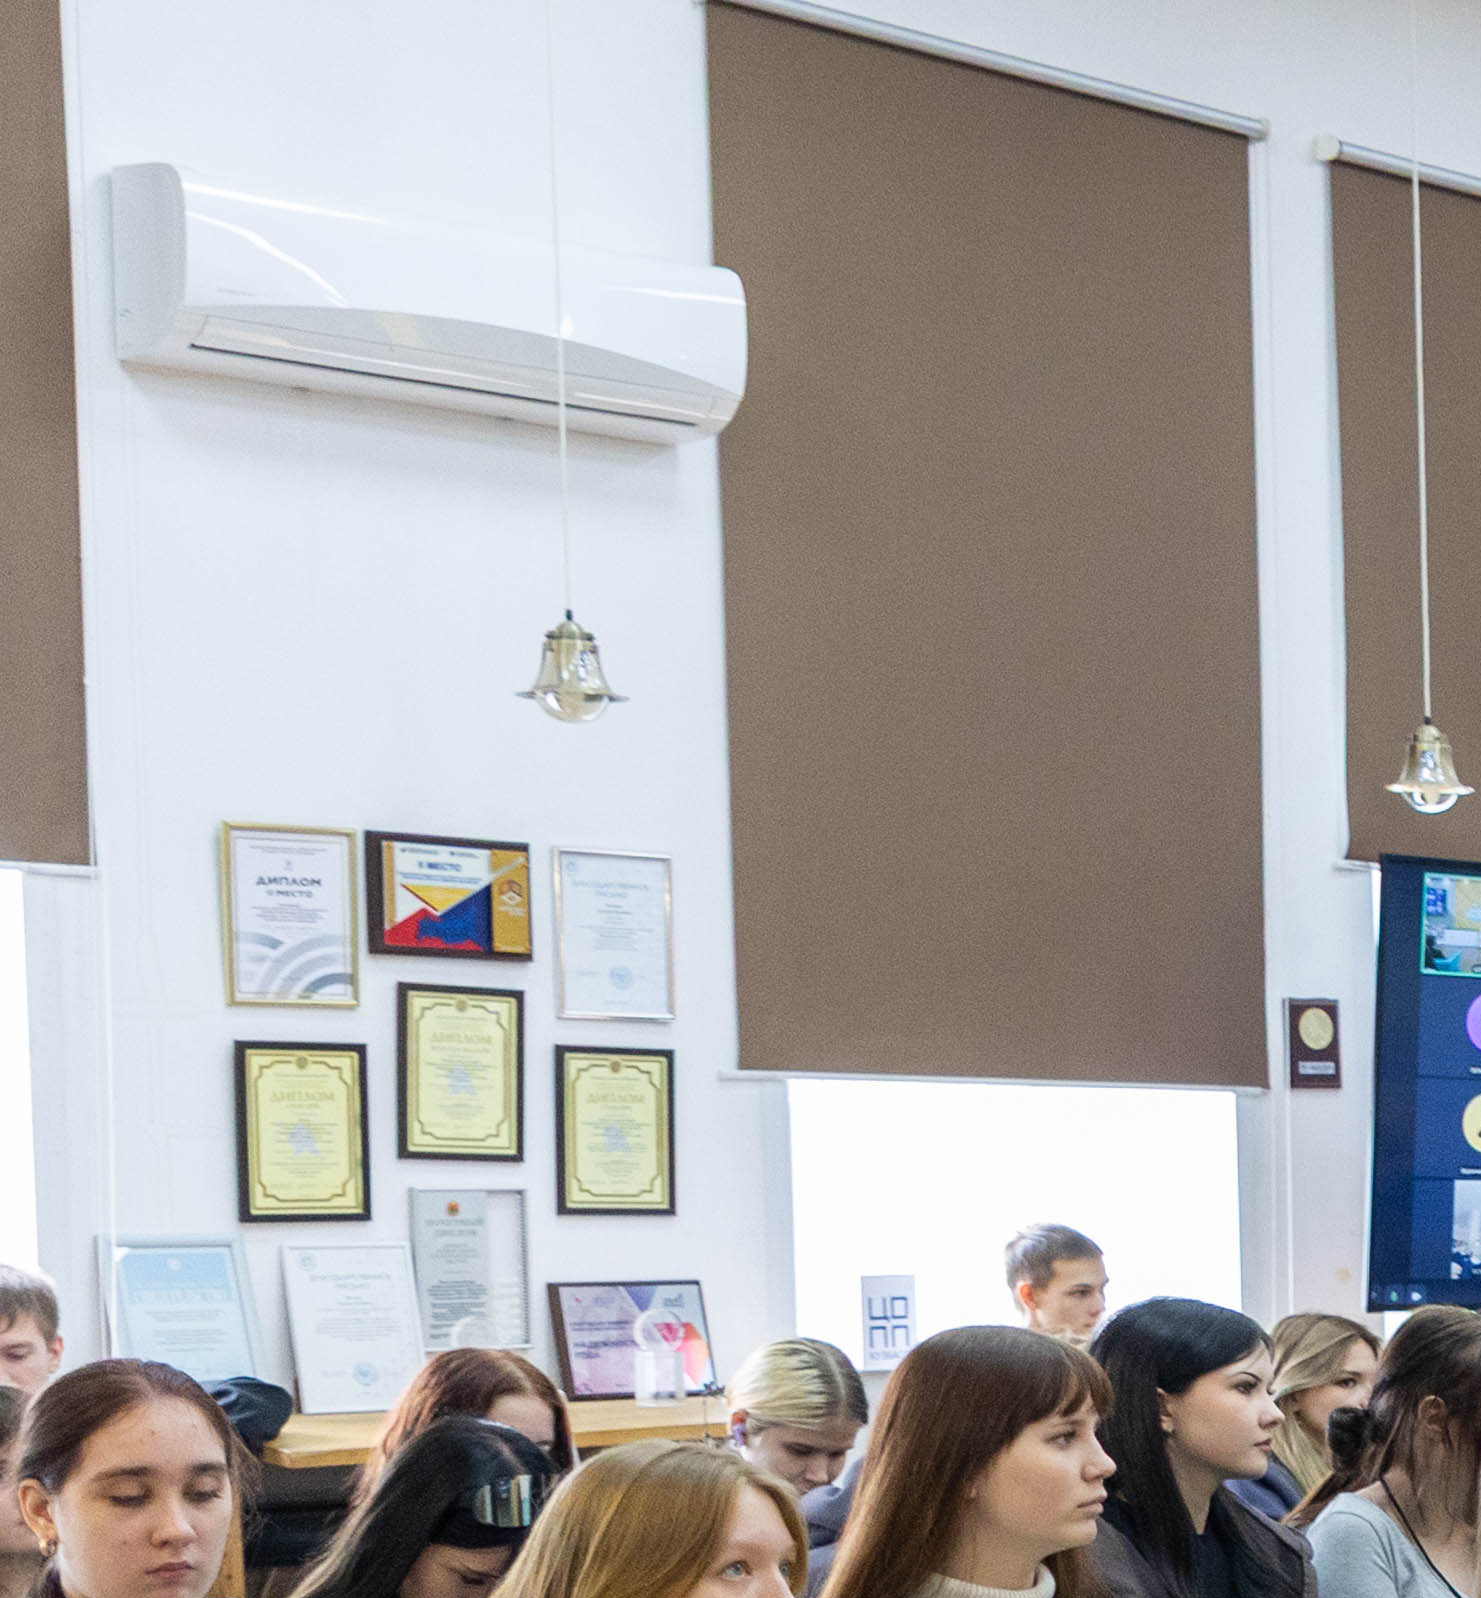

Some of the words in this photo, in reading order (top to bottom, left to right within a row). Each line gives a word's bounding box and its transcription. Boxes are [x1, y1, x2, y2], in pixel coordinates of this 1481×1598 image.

[256, 876, 322, 887] ДИПЛОМ
[868, 1296, 909, 1322] ЦО
[869, 1325, 910, 1348] ПП
